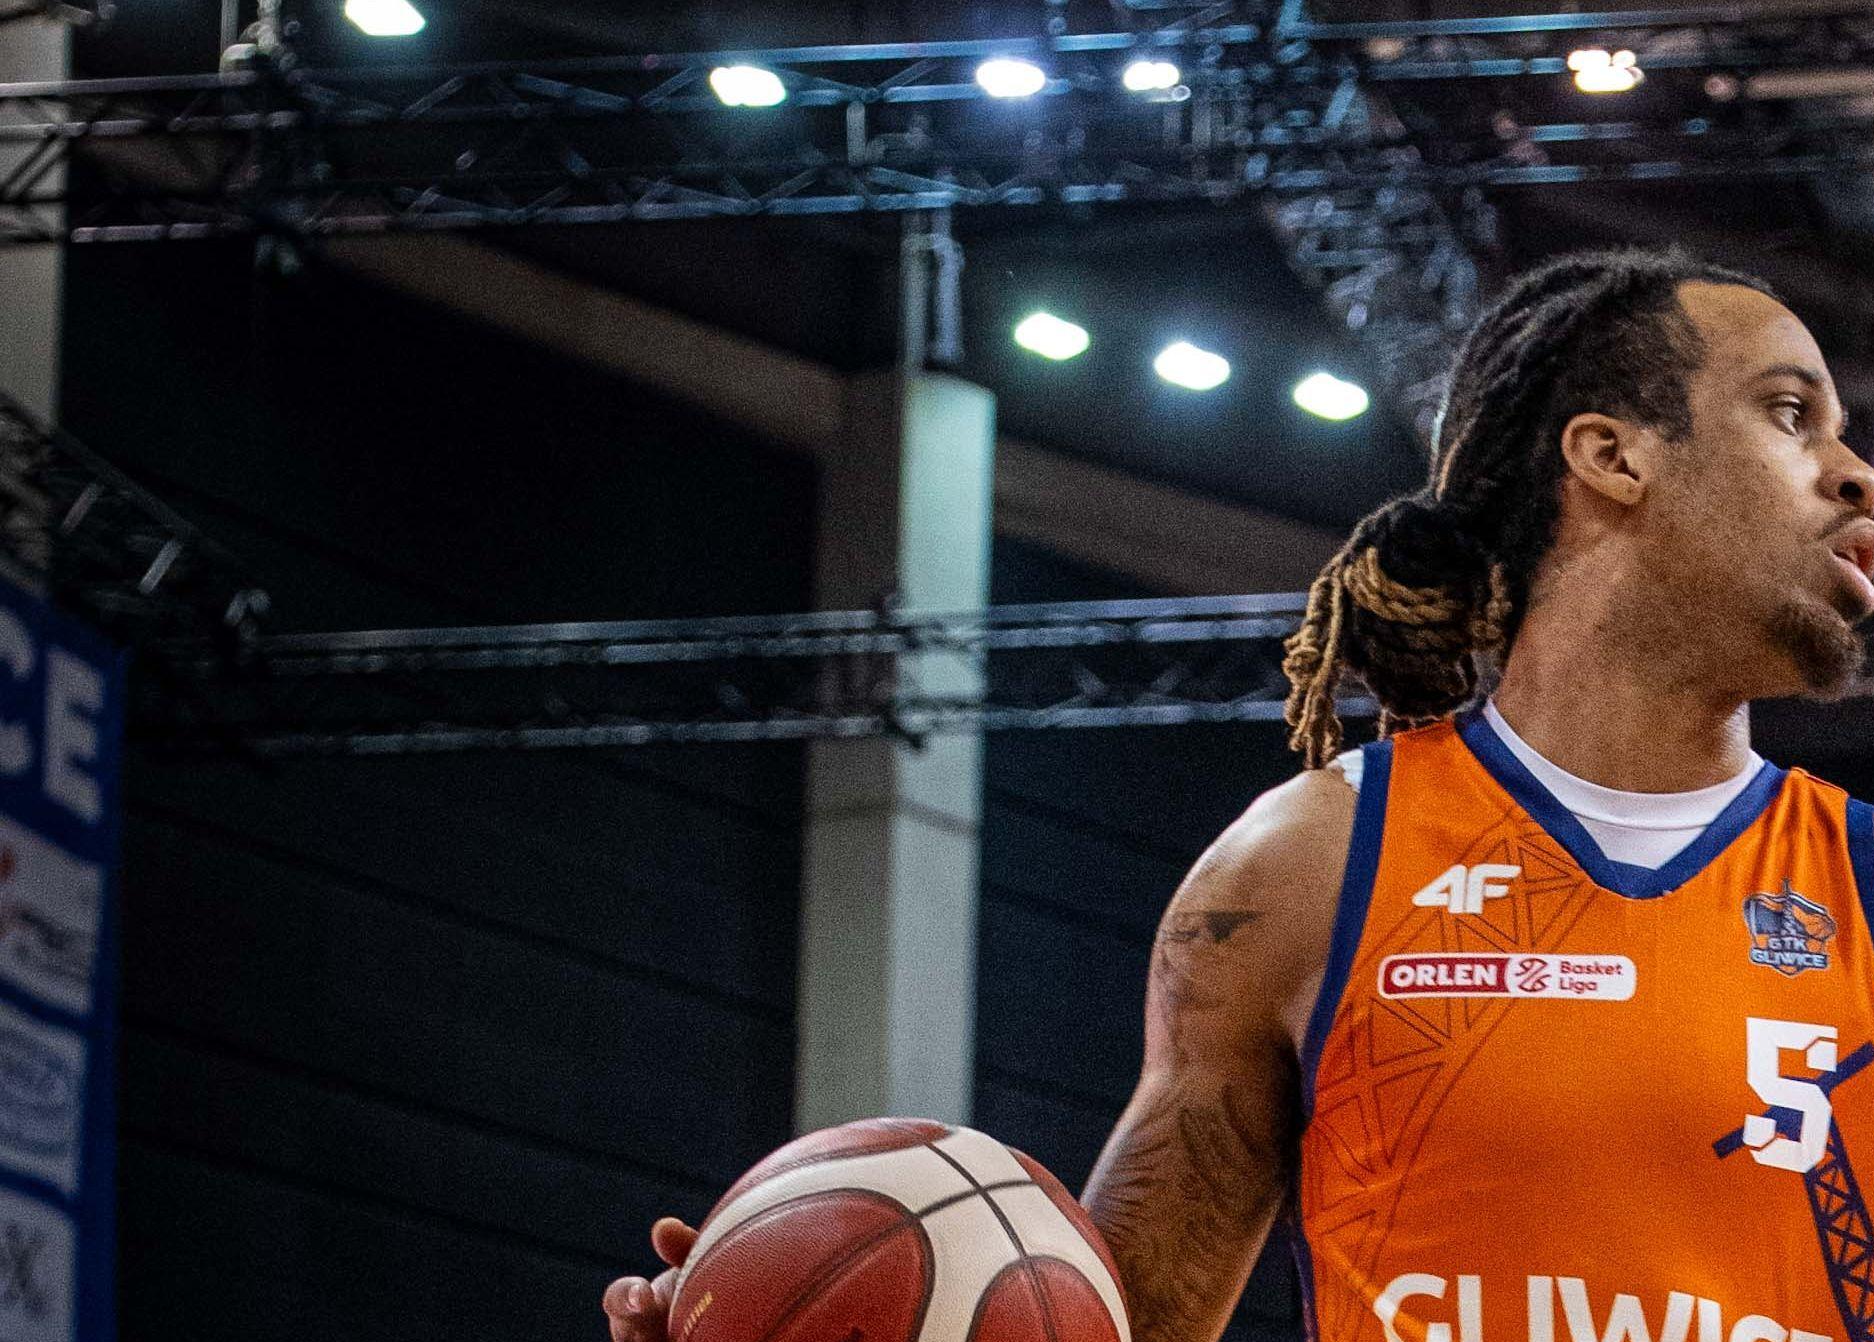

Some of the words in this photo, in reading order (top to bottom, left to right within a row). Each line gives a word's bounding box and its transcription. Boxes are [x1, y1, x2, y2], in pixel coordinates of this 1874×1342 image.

[1412, 864, 1521, 914] 4F
[1767, 936, 1807, 951] GTK
[1751, 949, 1827, 968] GLIWICE
[1391, 963, 1497, 988] ORLEN
[1560, 961, 1624, 977] Basket
[1560, 977, 1598, 994] Liga
[1743, 1017, 1838, 1173] 5
